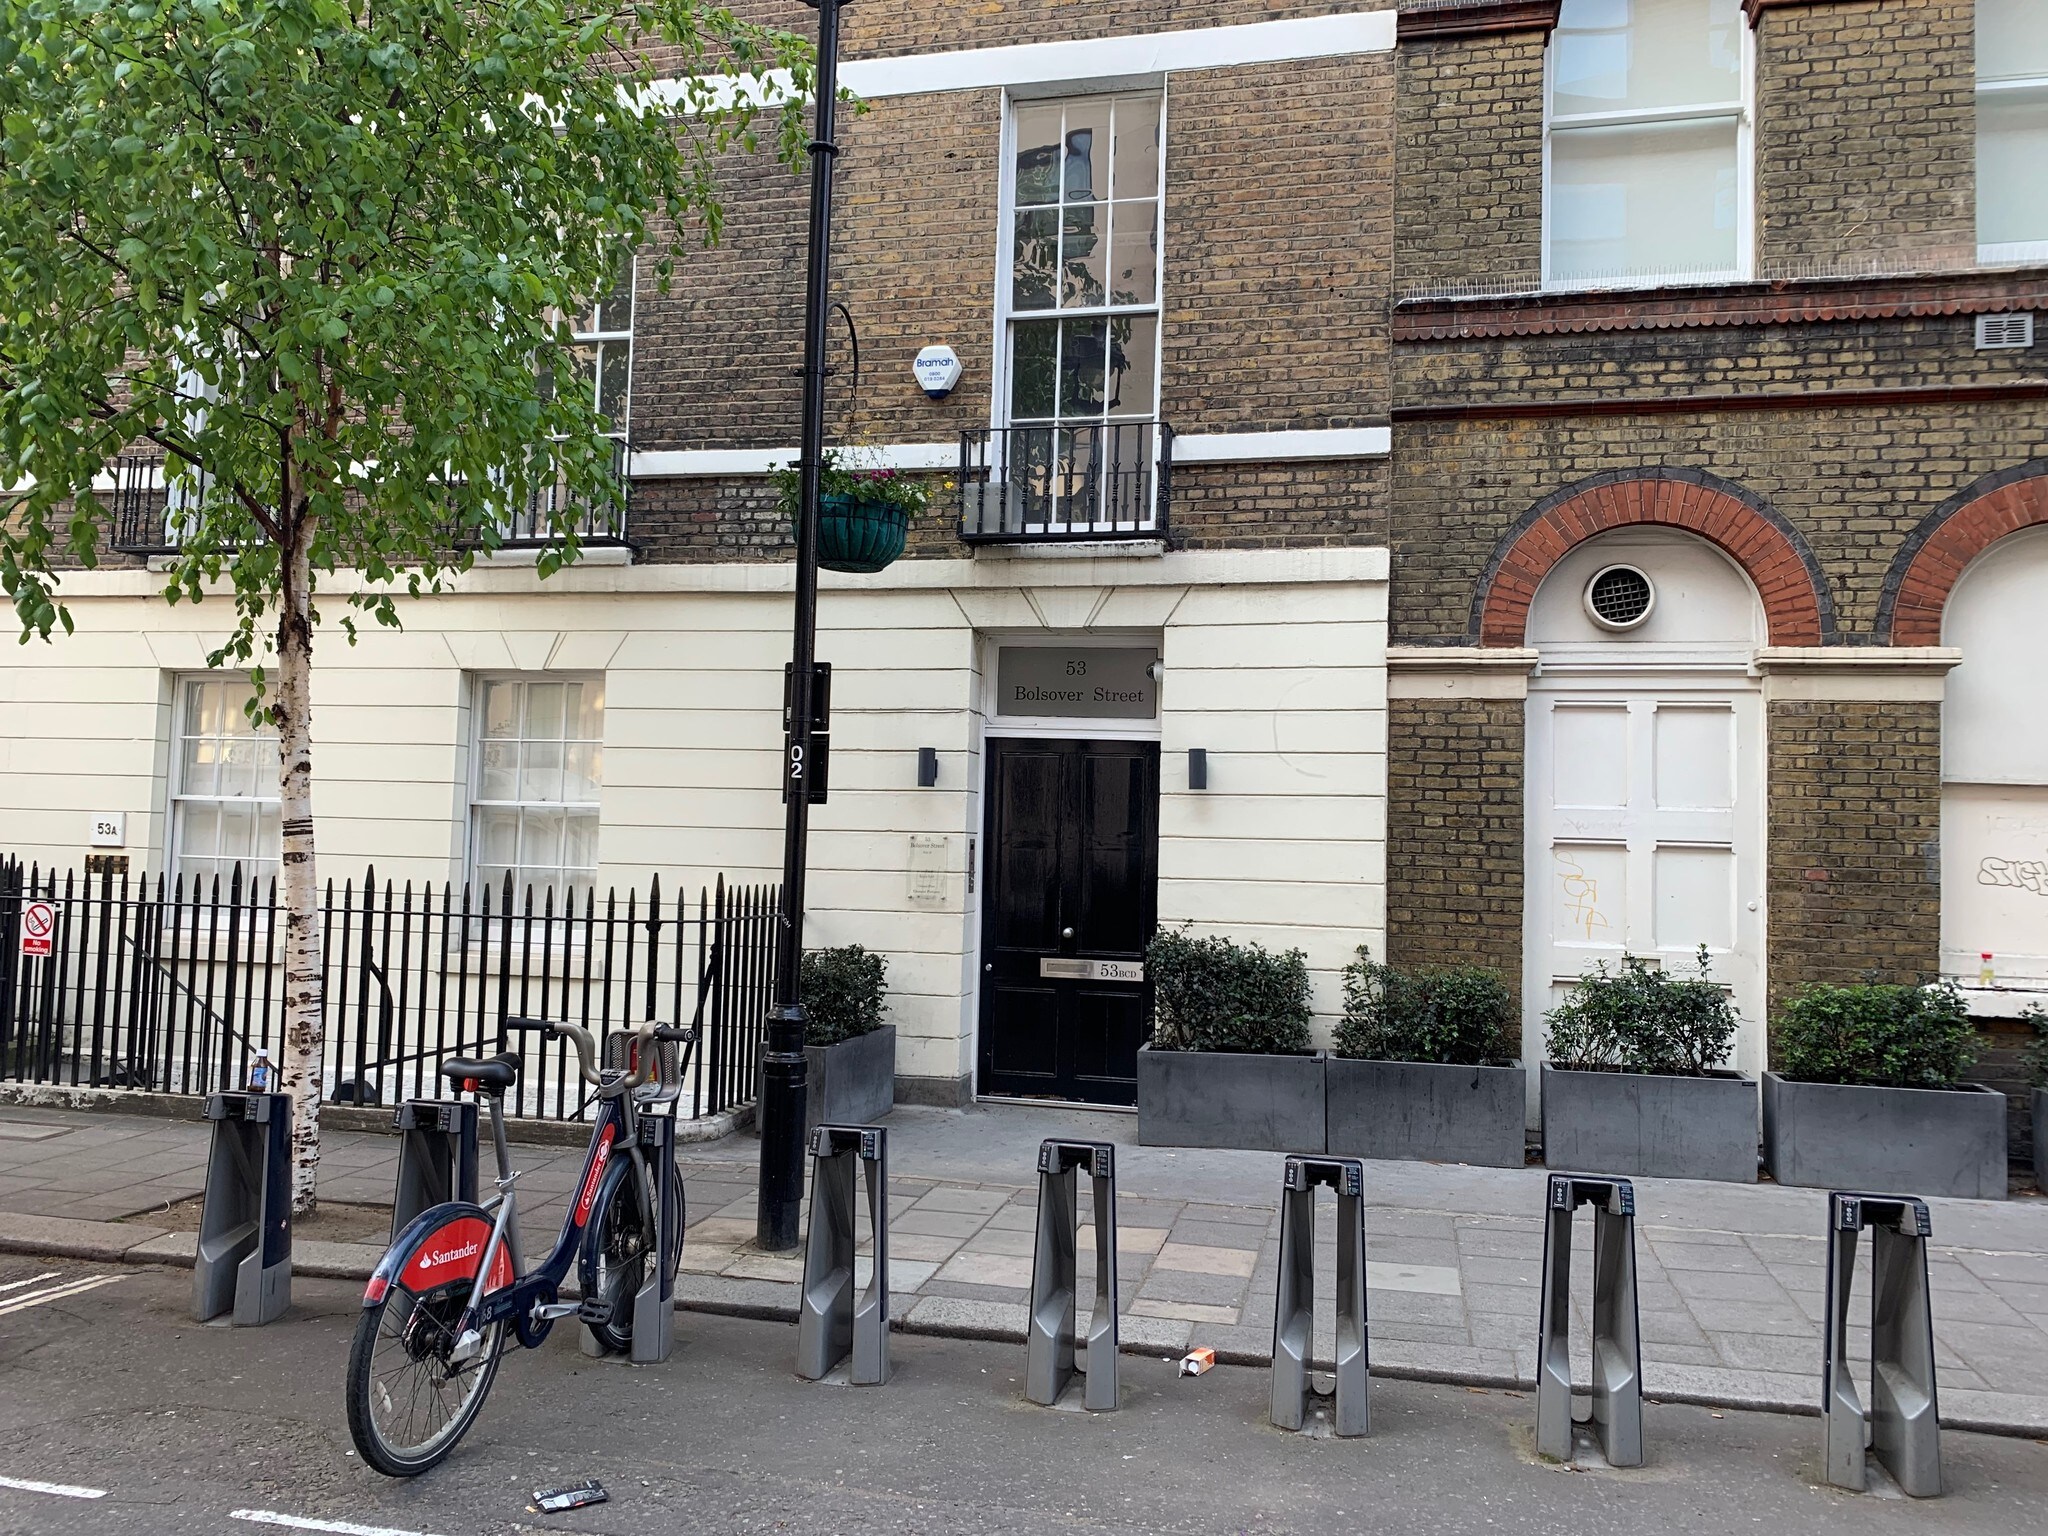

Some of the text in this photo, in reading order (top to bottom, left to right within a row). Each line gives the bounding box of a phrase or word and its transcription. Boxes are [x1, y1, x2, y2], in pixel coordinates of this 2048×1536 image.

[916, 357, 954, 367] Bramah
[1066, 661, 1087, 676] 53
[1014, 685, 1144, 702] Bolsover Street
[97, 822, 118, 836] 53A
[24, 946, 48, 954] smoking
[586, 1161, 602, 1198] Santander
[432, 1240, 478, 1267] Santander
